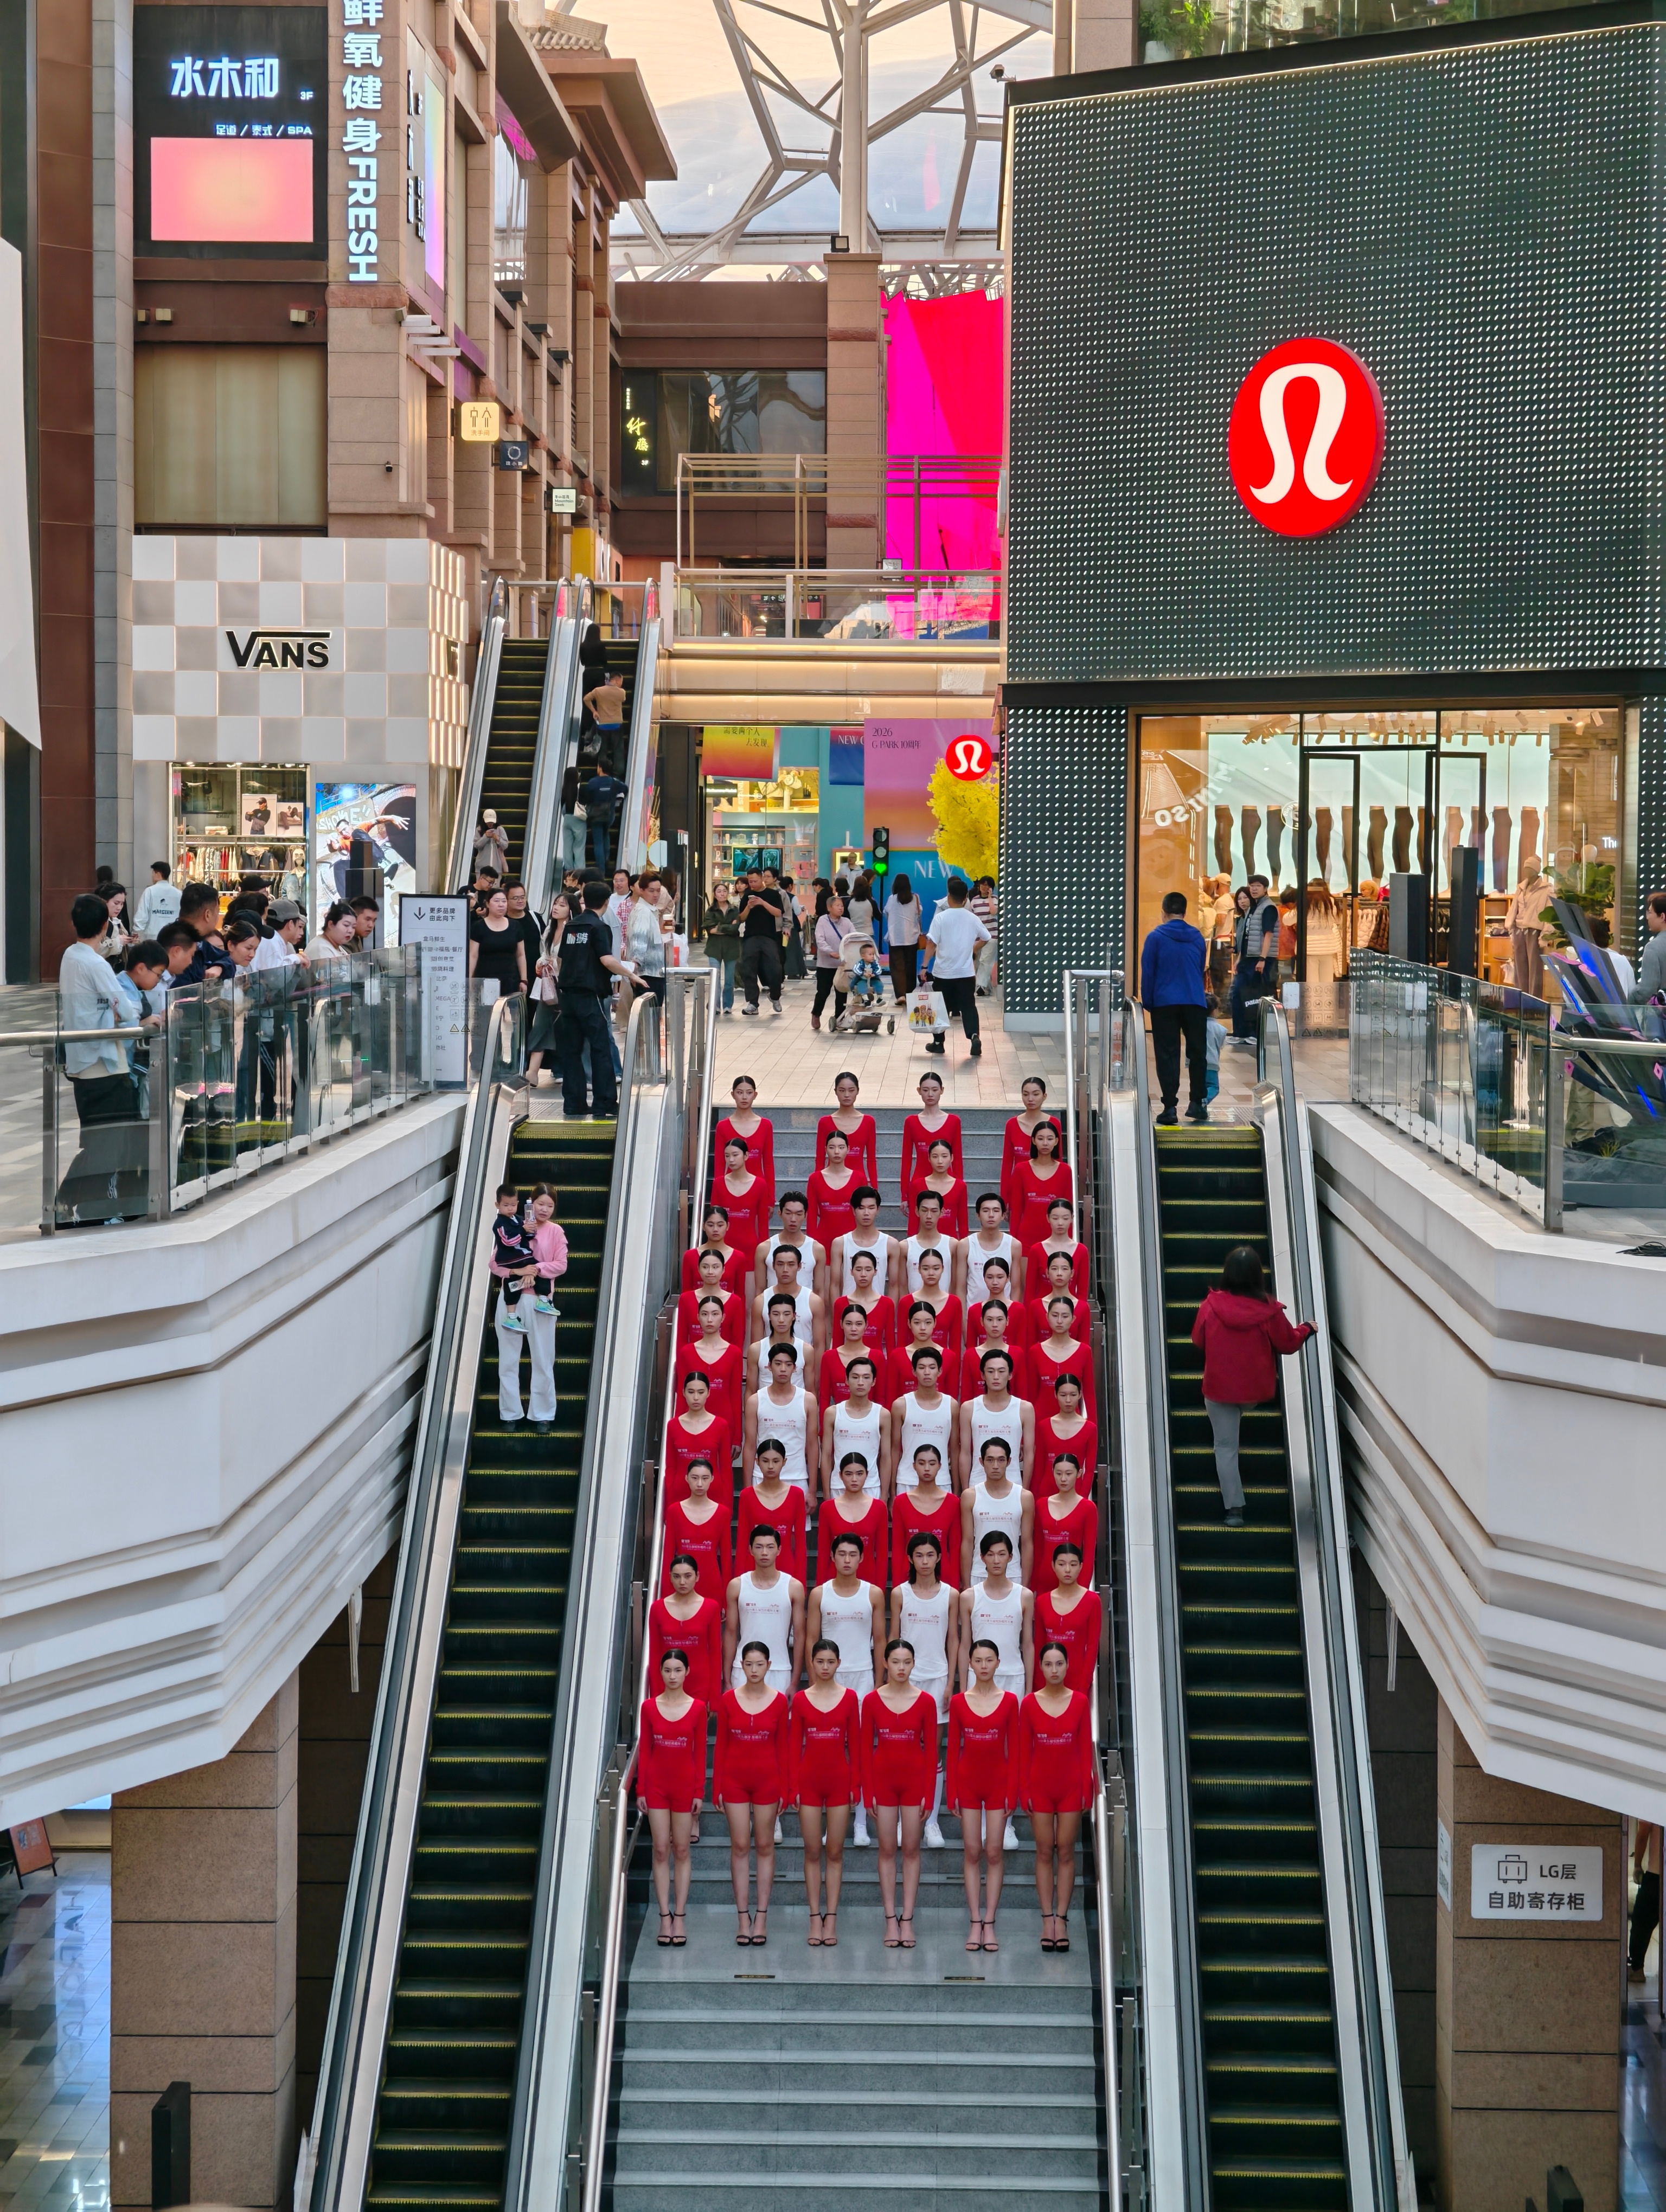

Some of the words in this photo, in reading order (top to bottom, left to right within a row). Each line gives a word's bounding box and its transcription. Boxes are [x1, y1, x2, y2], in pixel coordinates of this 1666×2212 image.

[171, 56, 279, 98] 水木和
[300, 91, 314, 100] 3F
[216, 124, 236, 136] 足道
[287, 126, 313, 135] SPA
[226, 630, 331, 669] VANS
[872, 728, 893, 737] 2026
[838, 735, 857, 745] NEW
[872, 740, 878, 749] G
[880, 740, 899, 749] PARK
[914, 860, 954, 878] NEW
[1539, 1863, 1577, 1880] LG层
[1488, 1891, 1585, 1911] 自助寄存柜
